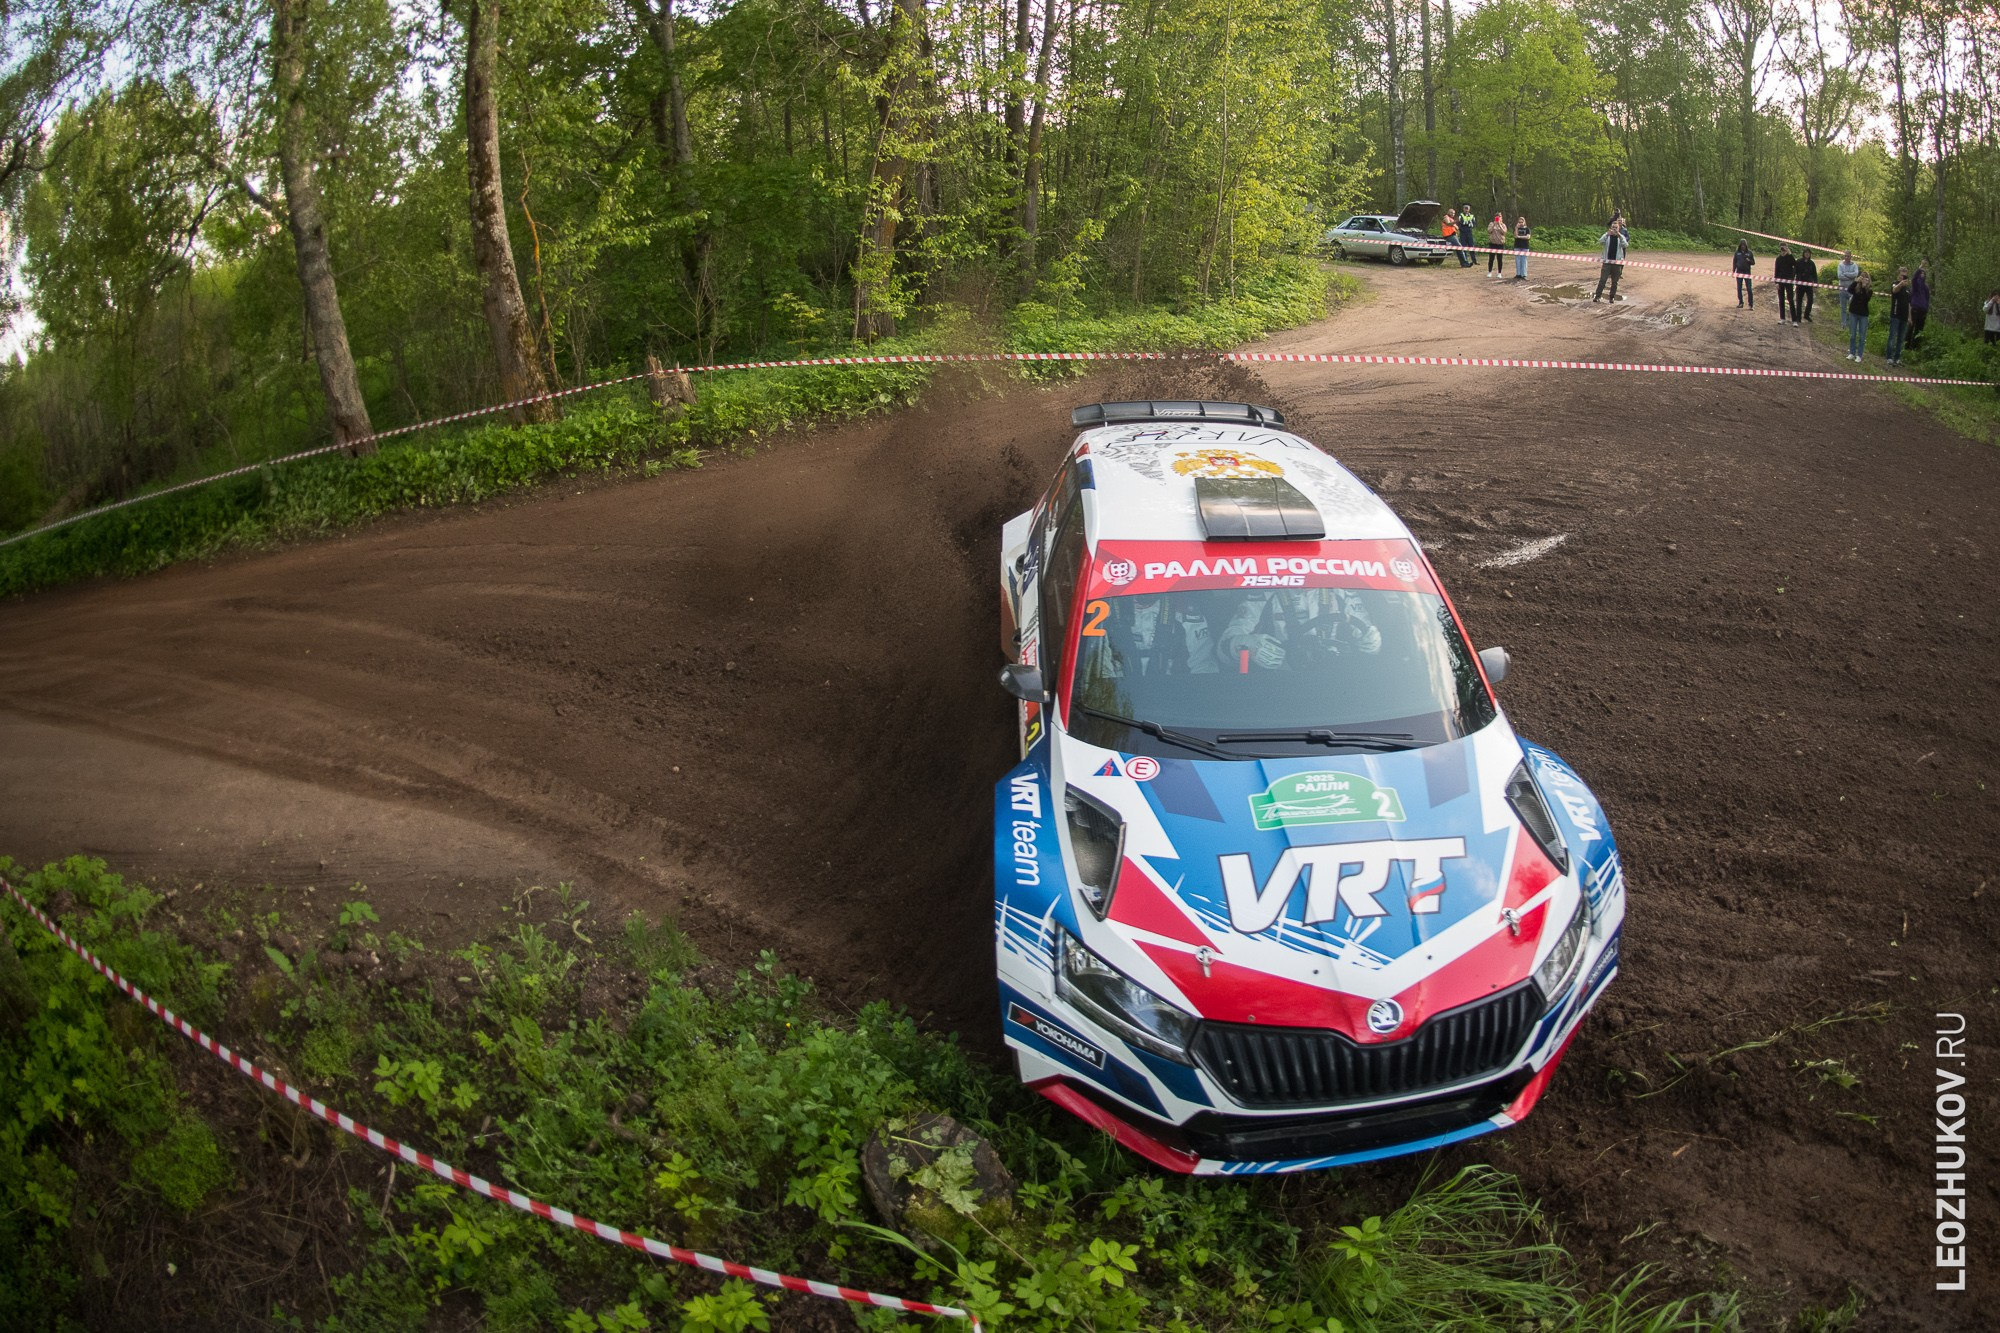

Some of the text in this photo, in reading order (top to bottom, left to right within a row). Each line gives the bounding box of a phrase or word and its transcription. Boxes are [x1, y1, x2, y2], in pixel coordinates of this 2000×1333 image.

[1144, 557, 1387, 580] РАЛЛИ РОССИИ
[1082, 600, 1111, 637] 2
[1135, 762, 1150, 775] E
[1305, 774, 1335, 783] 2025
[1295, 781, 1350, 793] РАЛЛИ
[1527, 747, 1602, 842] VRT team
[1371, 791, 1397, 819] 2
[1010, 772, 1041, 886] VRT team
[1217, 836, 1468, 934] VRT
[1035, 1020, 1098, 1063] YOKOHAMA
